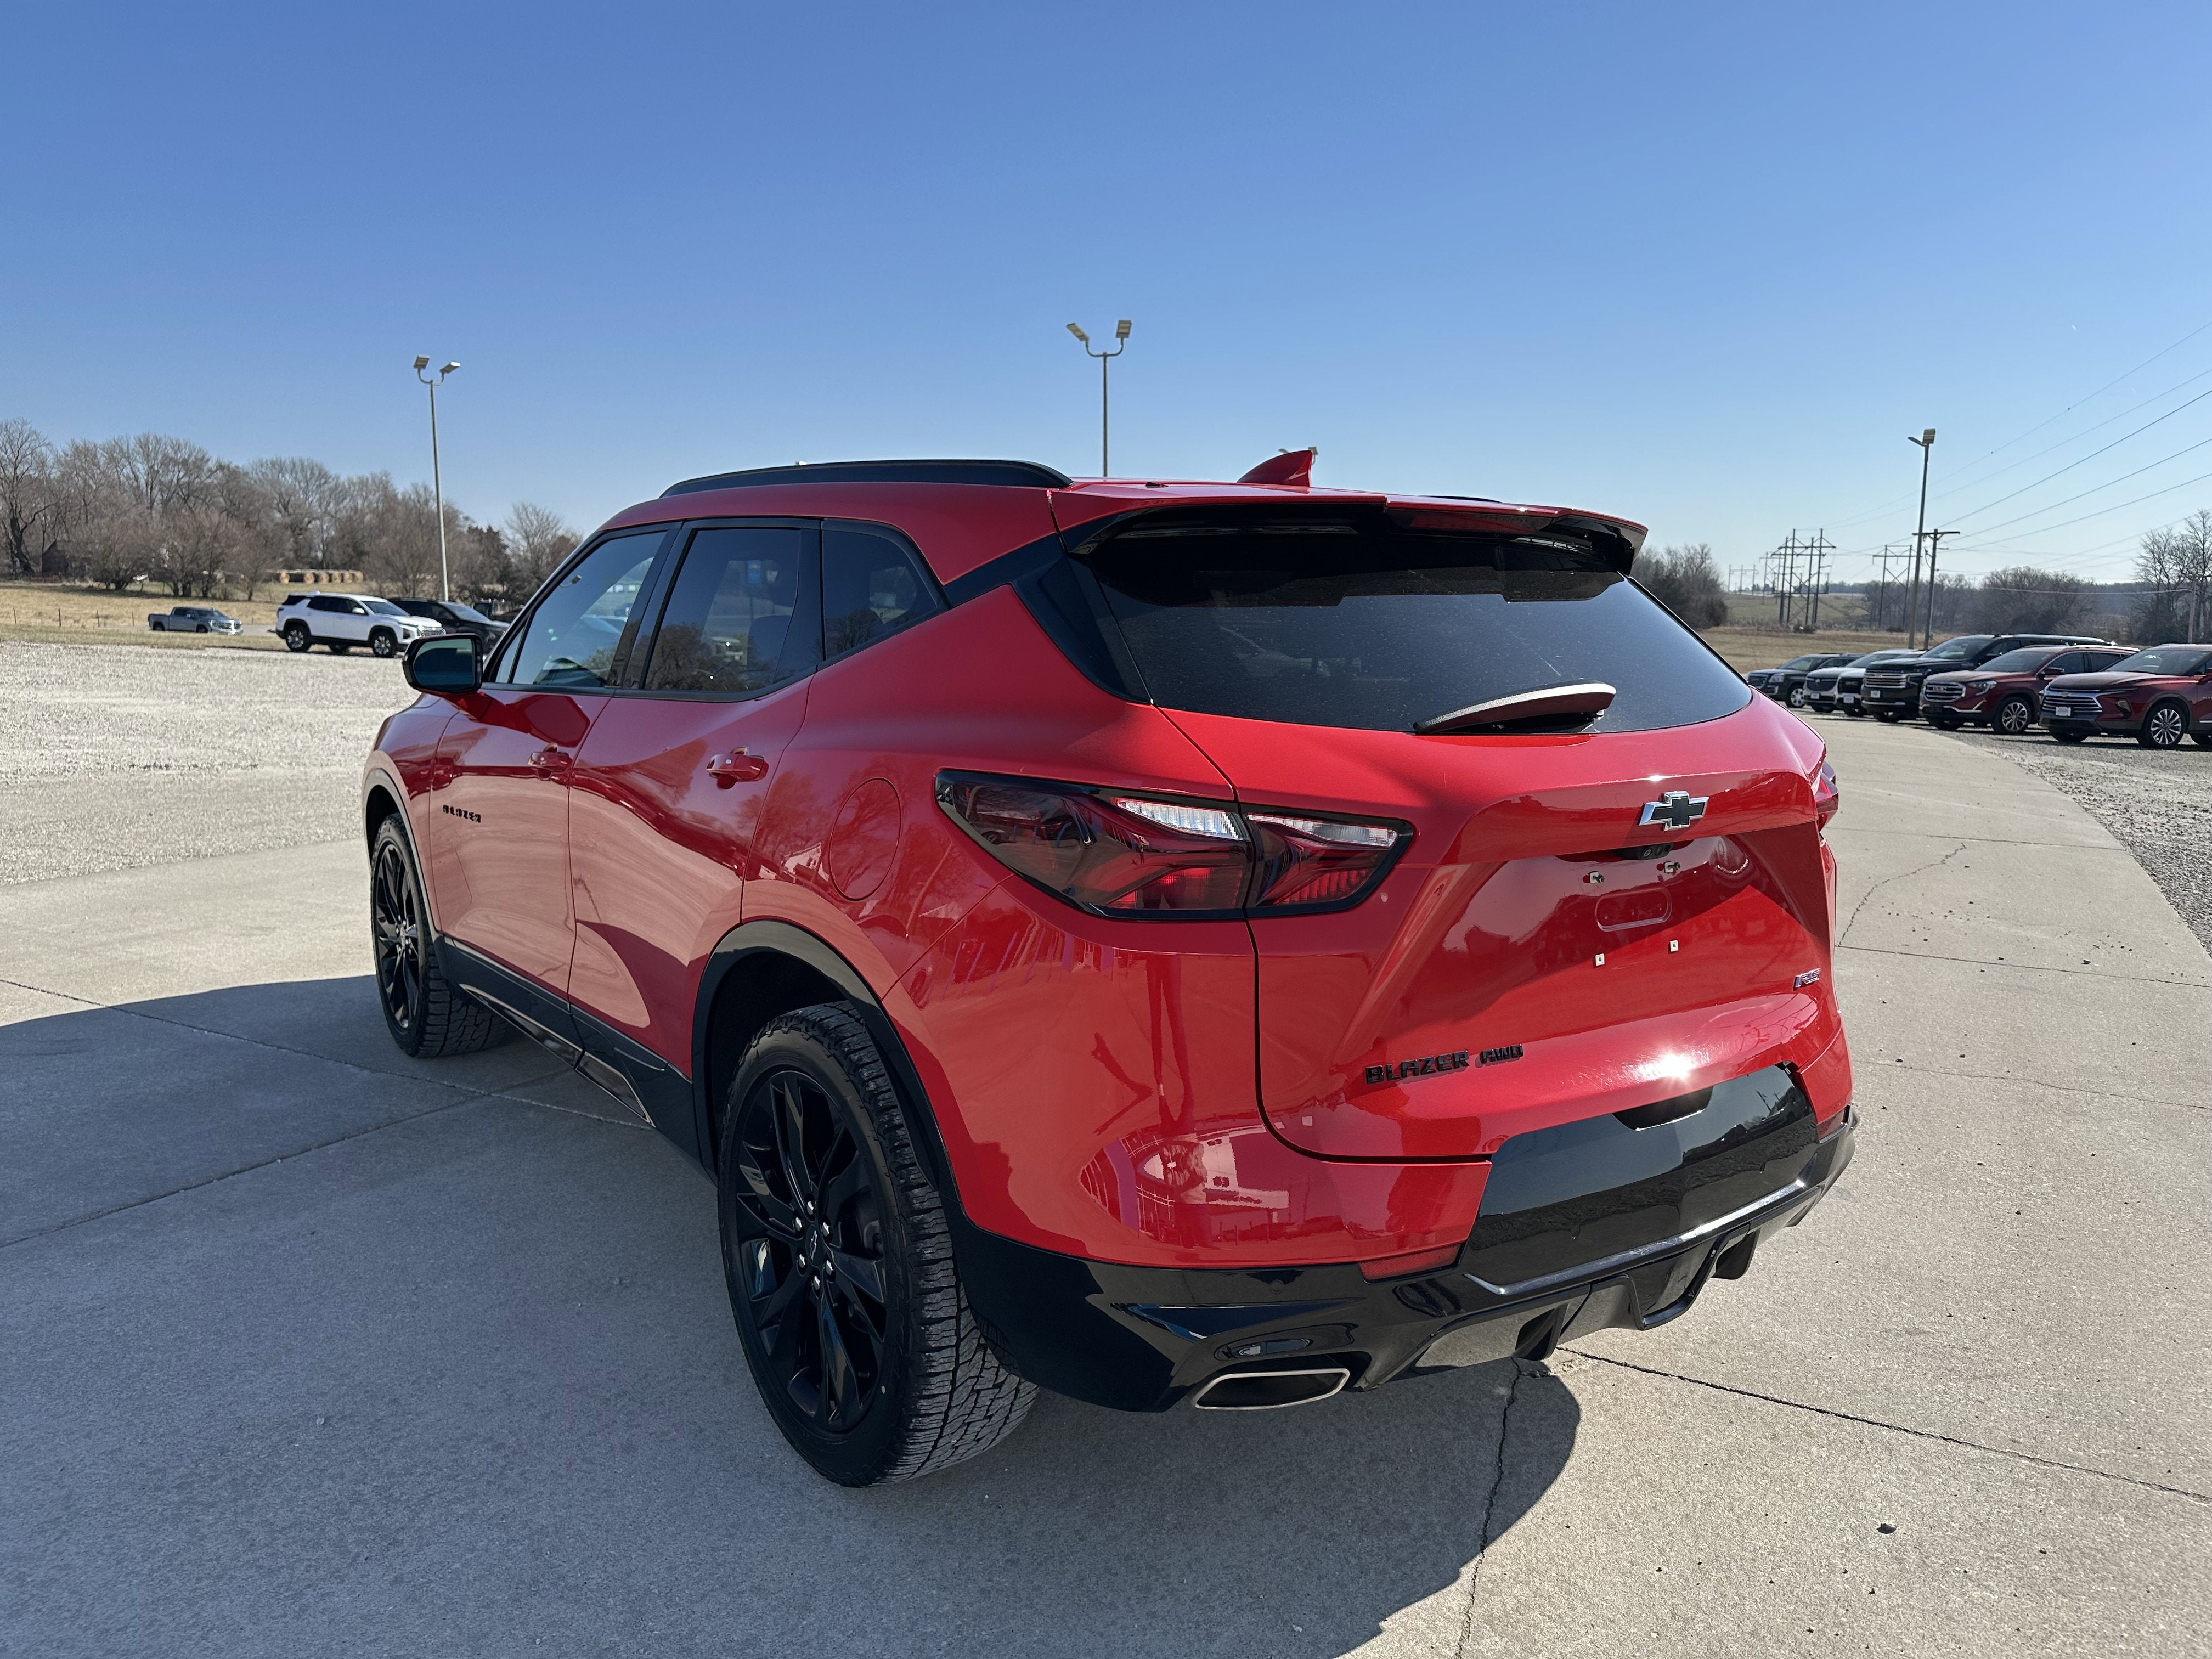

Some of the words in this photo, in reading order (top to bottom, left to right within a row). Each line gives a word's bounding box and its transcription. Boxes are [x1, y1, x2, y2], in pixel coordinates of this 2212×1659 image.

[443, 805, 481, 823] BLAZER
[1793, 968, 1821, 989] RS
[1365, 1049, 1470, 1085] BLAZER
[1480, 1043, 1524, 1065] AWD
